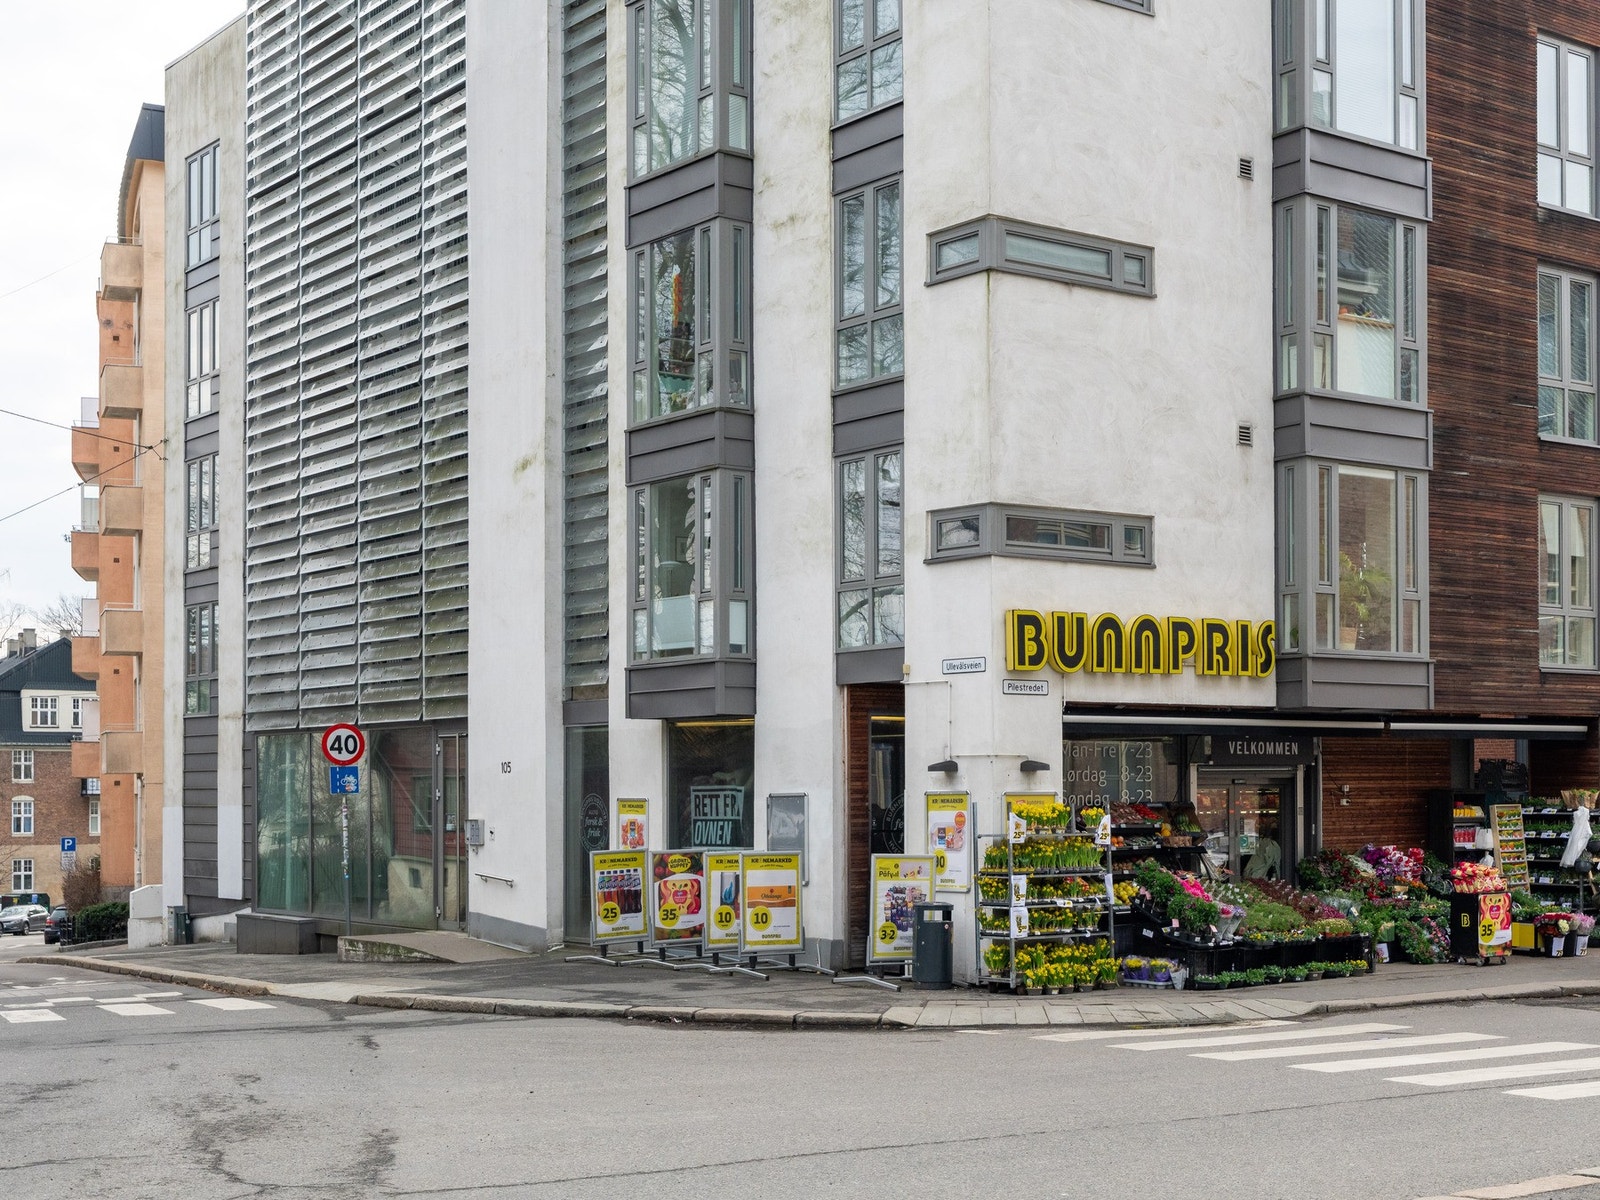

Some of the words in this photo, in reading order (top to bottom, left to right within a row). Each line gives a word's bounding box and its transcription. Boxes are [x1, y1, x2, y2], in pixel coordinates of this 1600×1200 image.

[1005, 608, 1275, 678] BUNNPRIS
[946, 661, 982, 671] Ullevålsveien
[1007, 682, 1044, 692] Pilestredet
[329, 734, 358, 755] 40
[1063, 741, 1117, 758] Man-Fre
[1122, 741, 1153, 758] 7-23
[1228, 741, 1299, 755] VELKOMMEN
[501, 761, 512, 774] 105
[1121, 765, 1153, 782] 8-23
[694, 794, 720, 817] RETT
[694, 820, 732, 845] OVNEN
[64, 839, 73, 850] P
[603, 908, 618, 919] 25
[717, 912, 732, 924] 10
[753, 912, 768, 925] 10
[881, 929, 887, 940] 3
[889, 929, 895, 940] 2
[1481, 923, 1493, 937] 35
